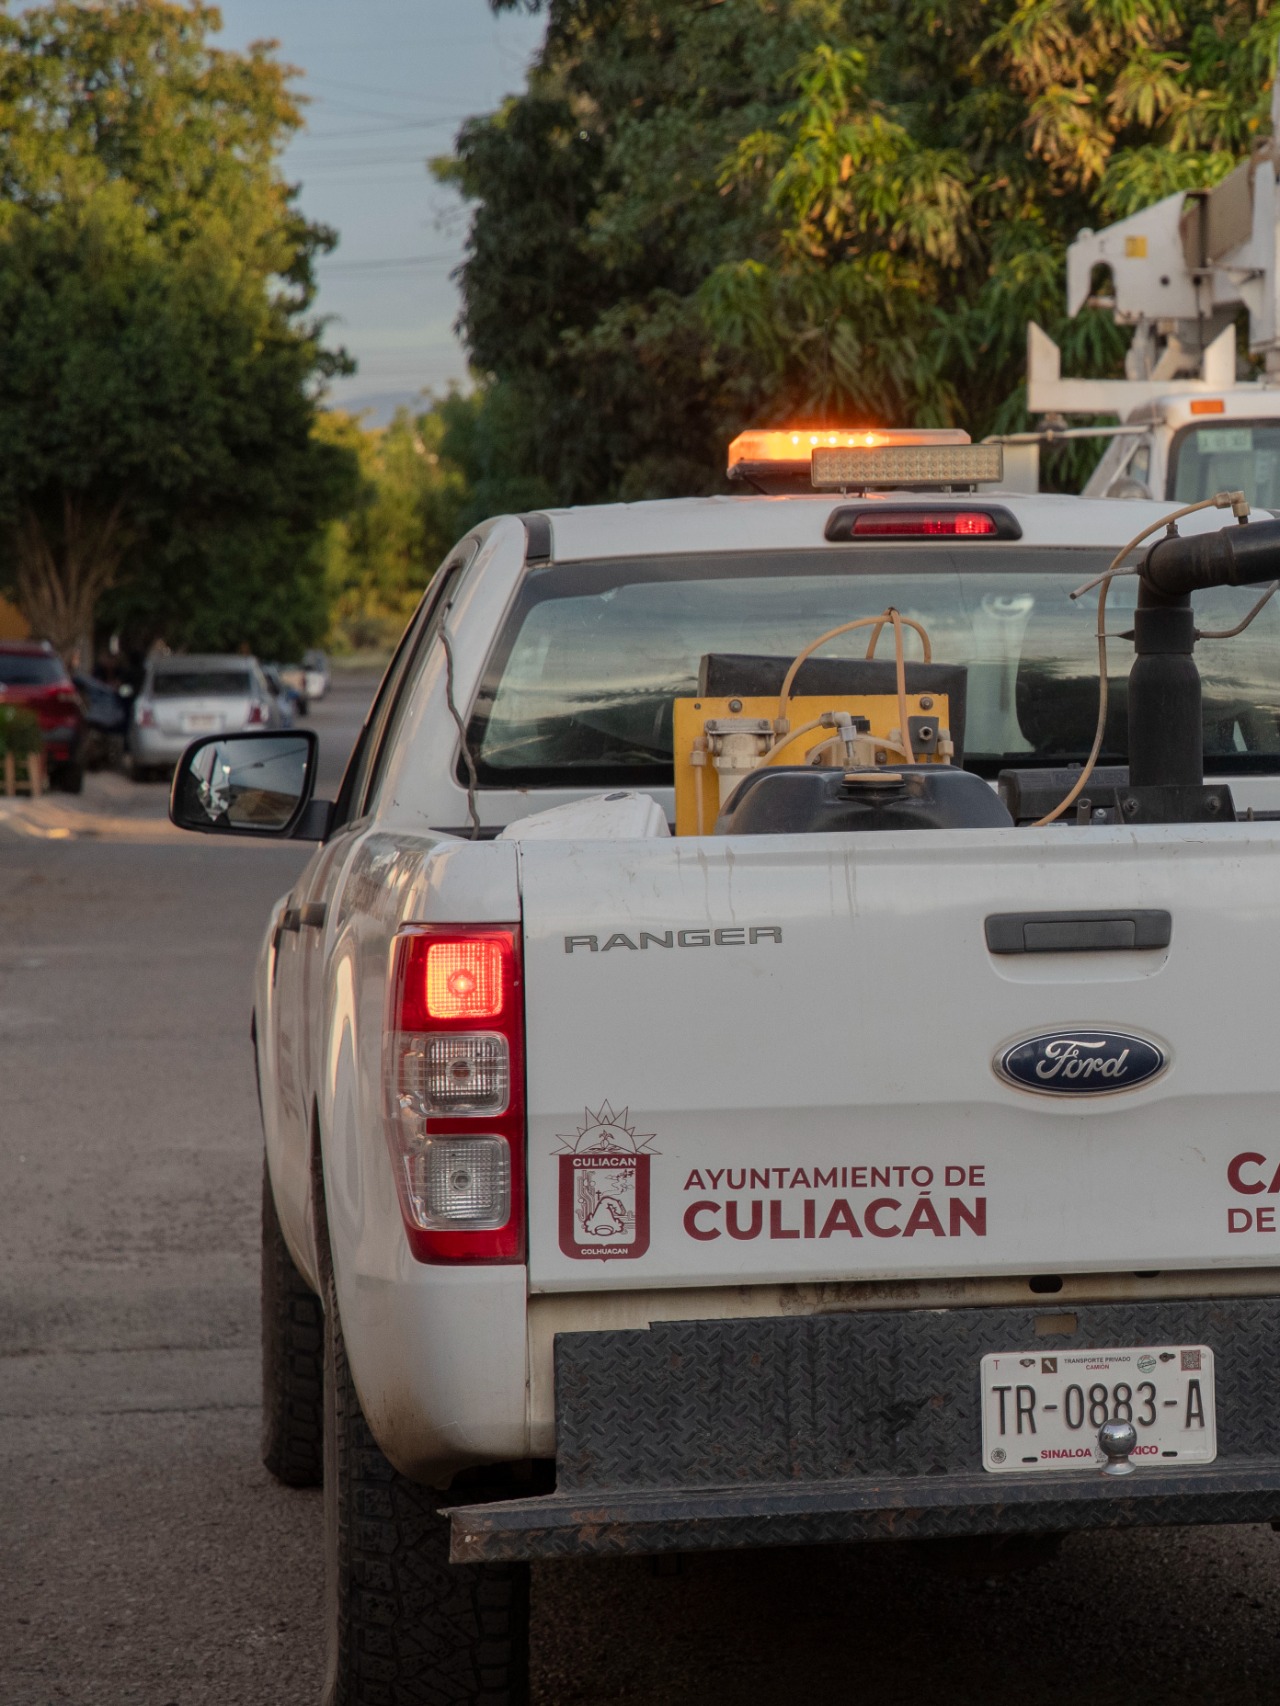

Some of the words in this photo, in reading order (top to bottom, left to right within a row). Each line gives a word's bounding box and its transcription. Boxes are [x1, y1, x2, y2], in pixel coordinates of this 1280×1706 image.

[565, 926, 782, 953] RANGER
[1035, 1040, 1130, 1079] Ford
[572, 1158, 637, 1167] CULIACAN
[684, 1166, 934, 1190] AYUNTAMIENTO
[945, 1165, 986, 1187] DE
[683, 1191, 987, 1241] CULIACÁN
[1227, 1206, 1276, 1233] DE
[992, 1378, 1205, 1435] TR-0883-A
[1040, 1448, 1092, 1459] SINALOA
[1130, 1445, 1159, 1456] XICO
